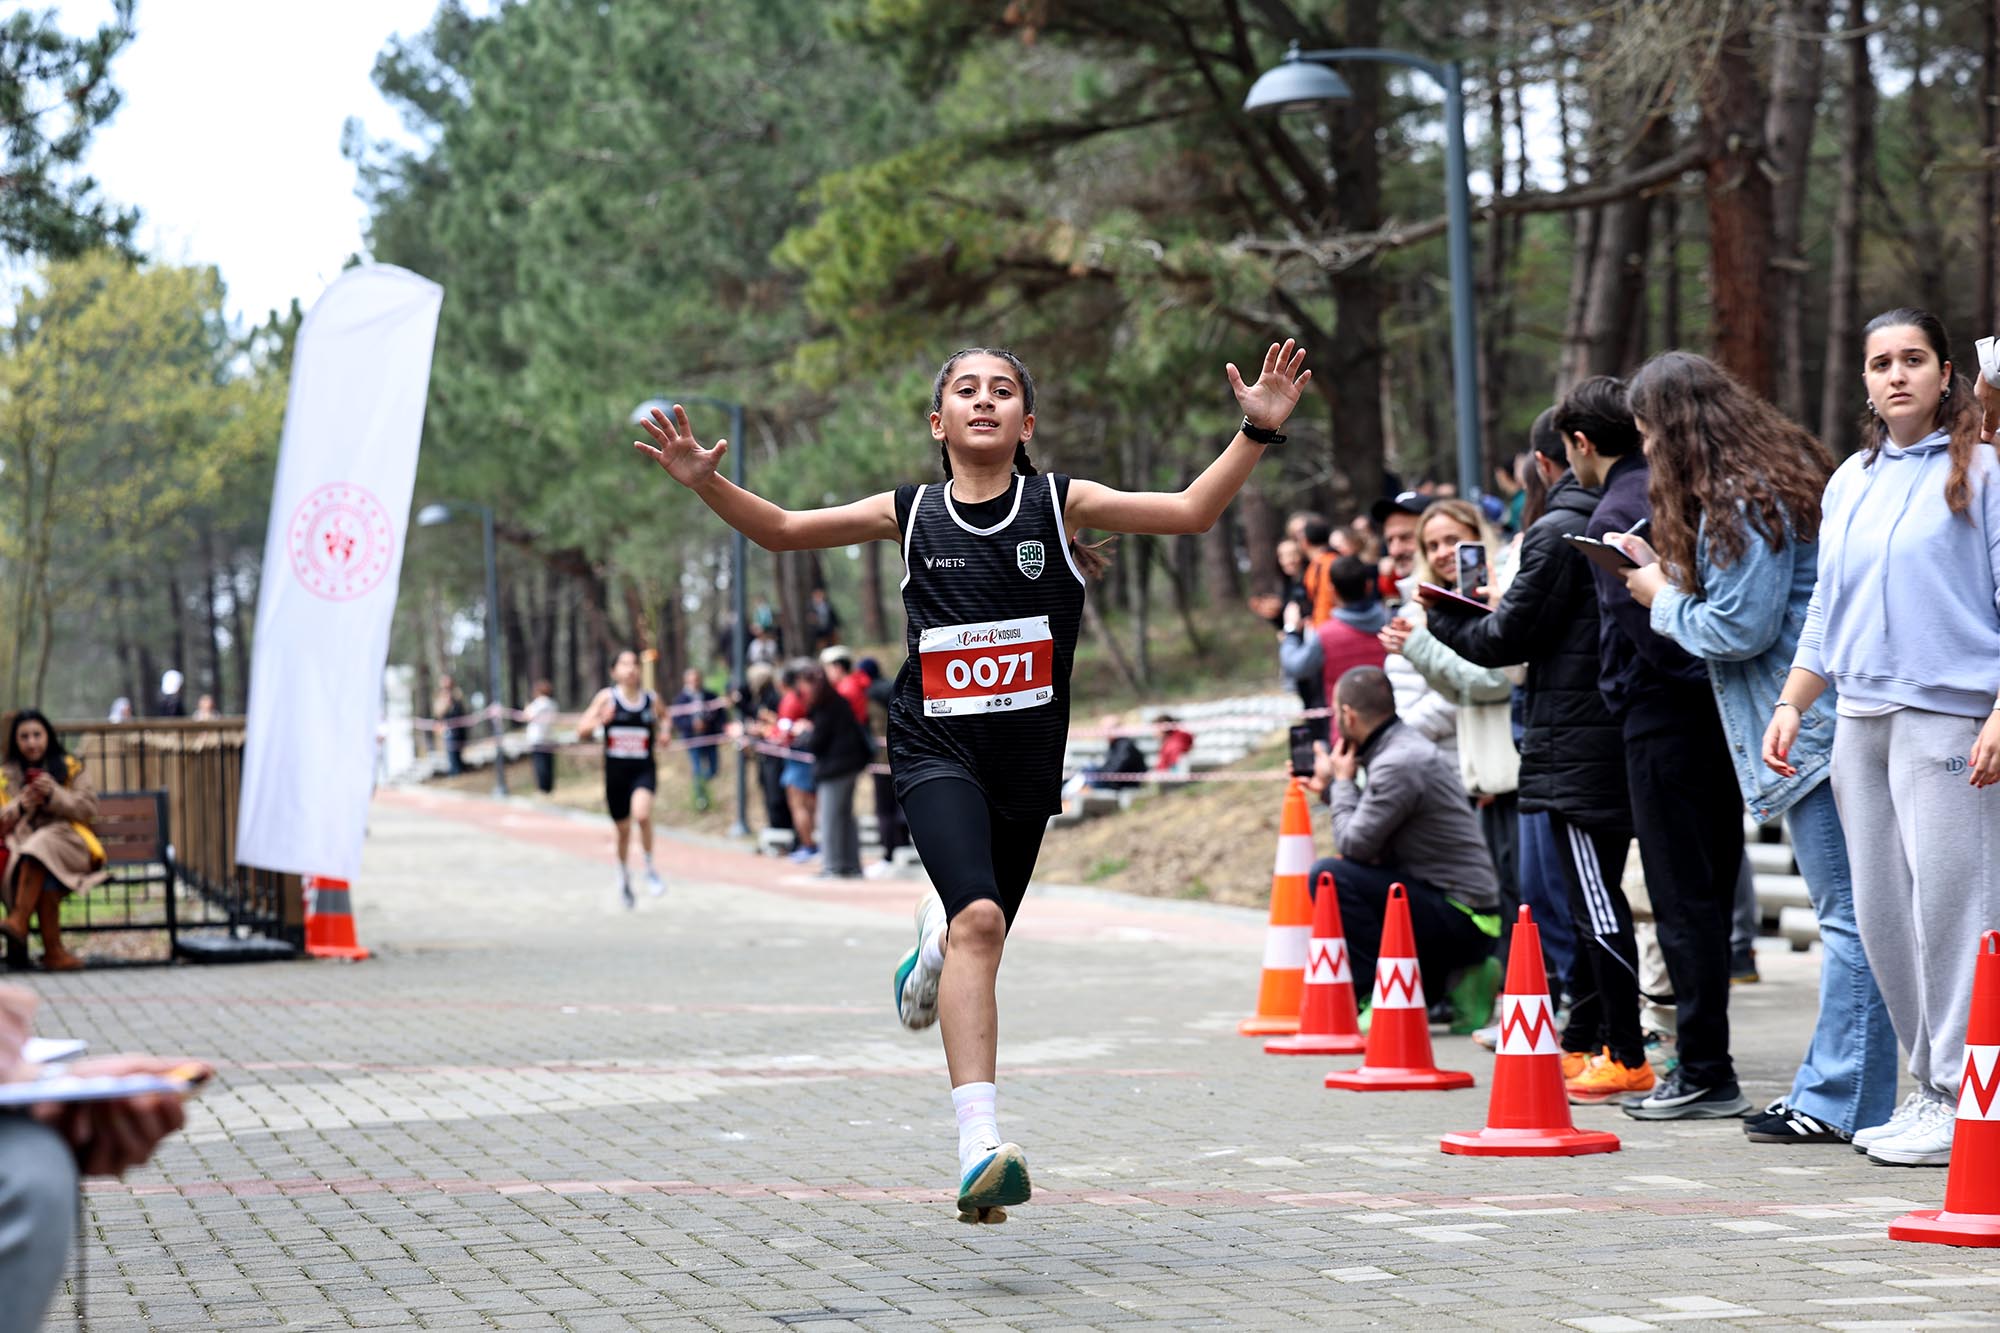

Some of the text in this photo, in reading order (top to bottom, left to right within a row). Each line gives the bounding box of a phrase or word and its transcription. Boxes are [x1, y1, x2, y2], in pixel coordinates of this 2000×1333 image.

[1020, 545, 1043, 561] SBB
[935, 558, 966, 568] METS
[945, 651, 1033, 690] 0071
